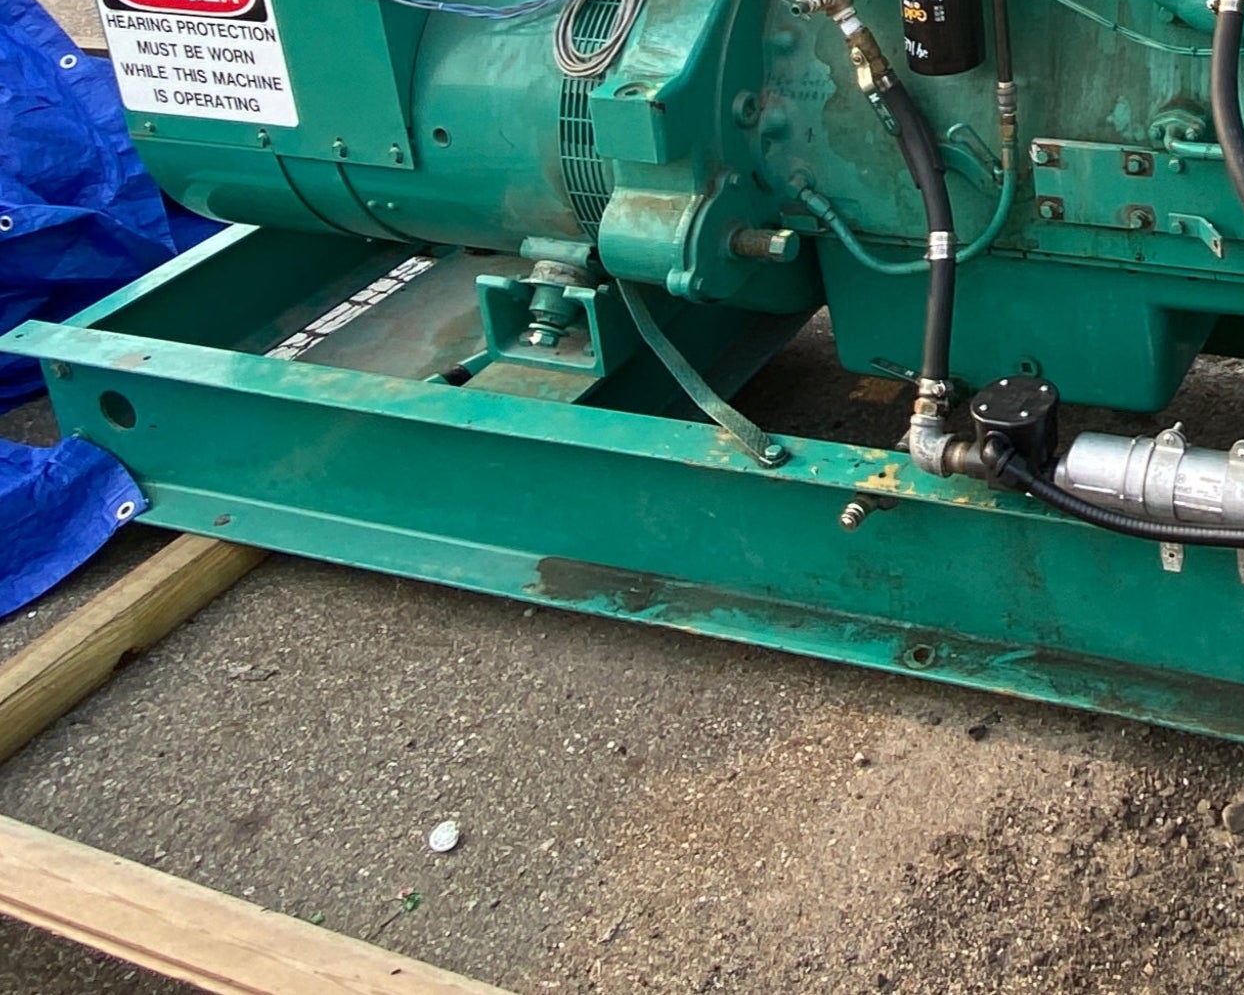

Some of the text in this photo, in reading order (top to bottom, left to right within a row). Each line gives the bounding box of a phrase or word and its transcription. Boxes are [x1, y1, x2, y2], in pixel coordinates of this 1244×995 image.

[106, 14, 277, 42] HEARING PROTECTION
[137, 40, 255, 64] MUST BE WORN
[120, 62, 283, 91] WHILE THIS MACHINE
[154, 88, 260, 112] IS OPERATING
